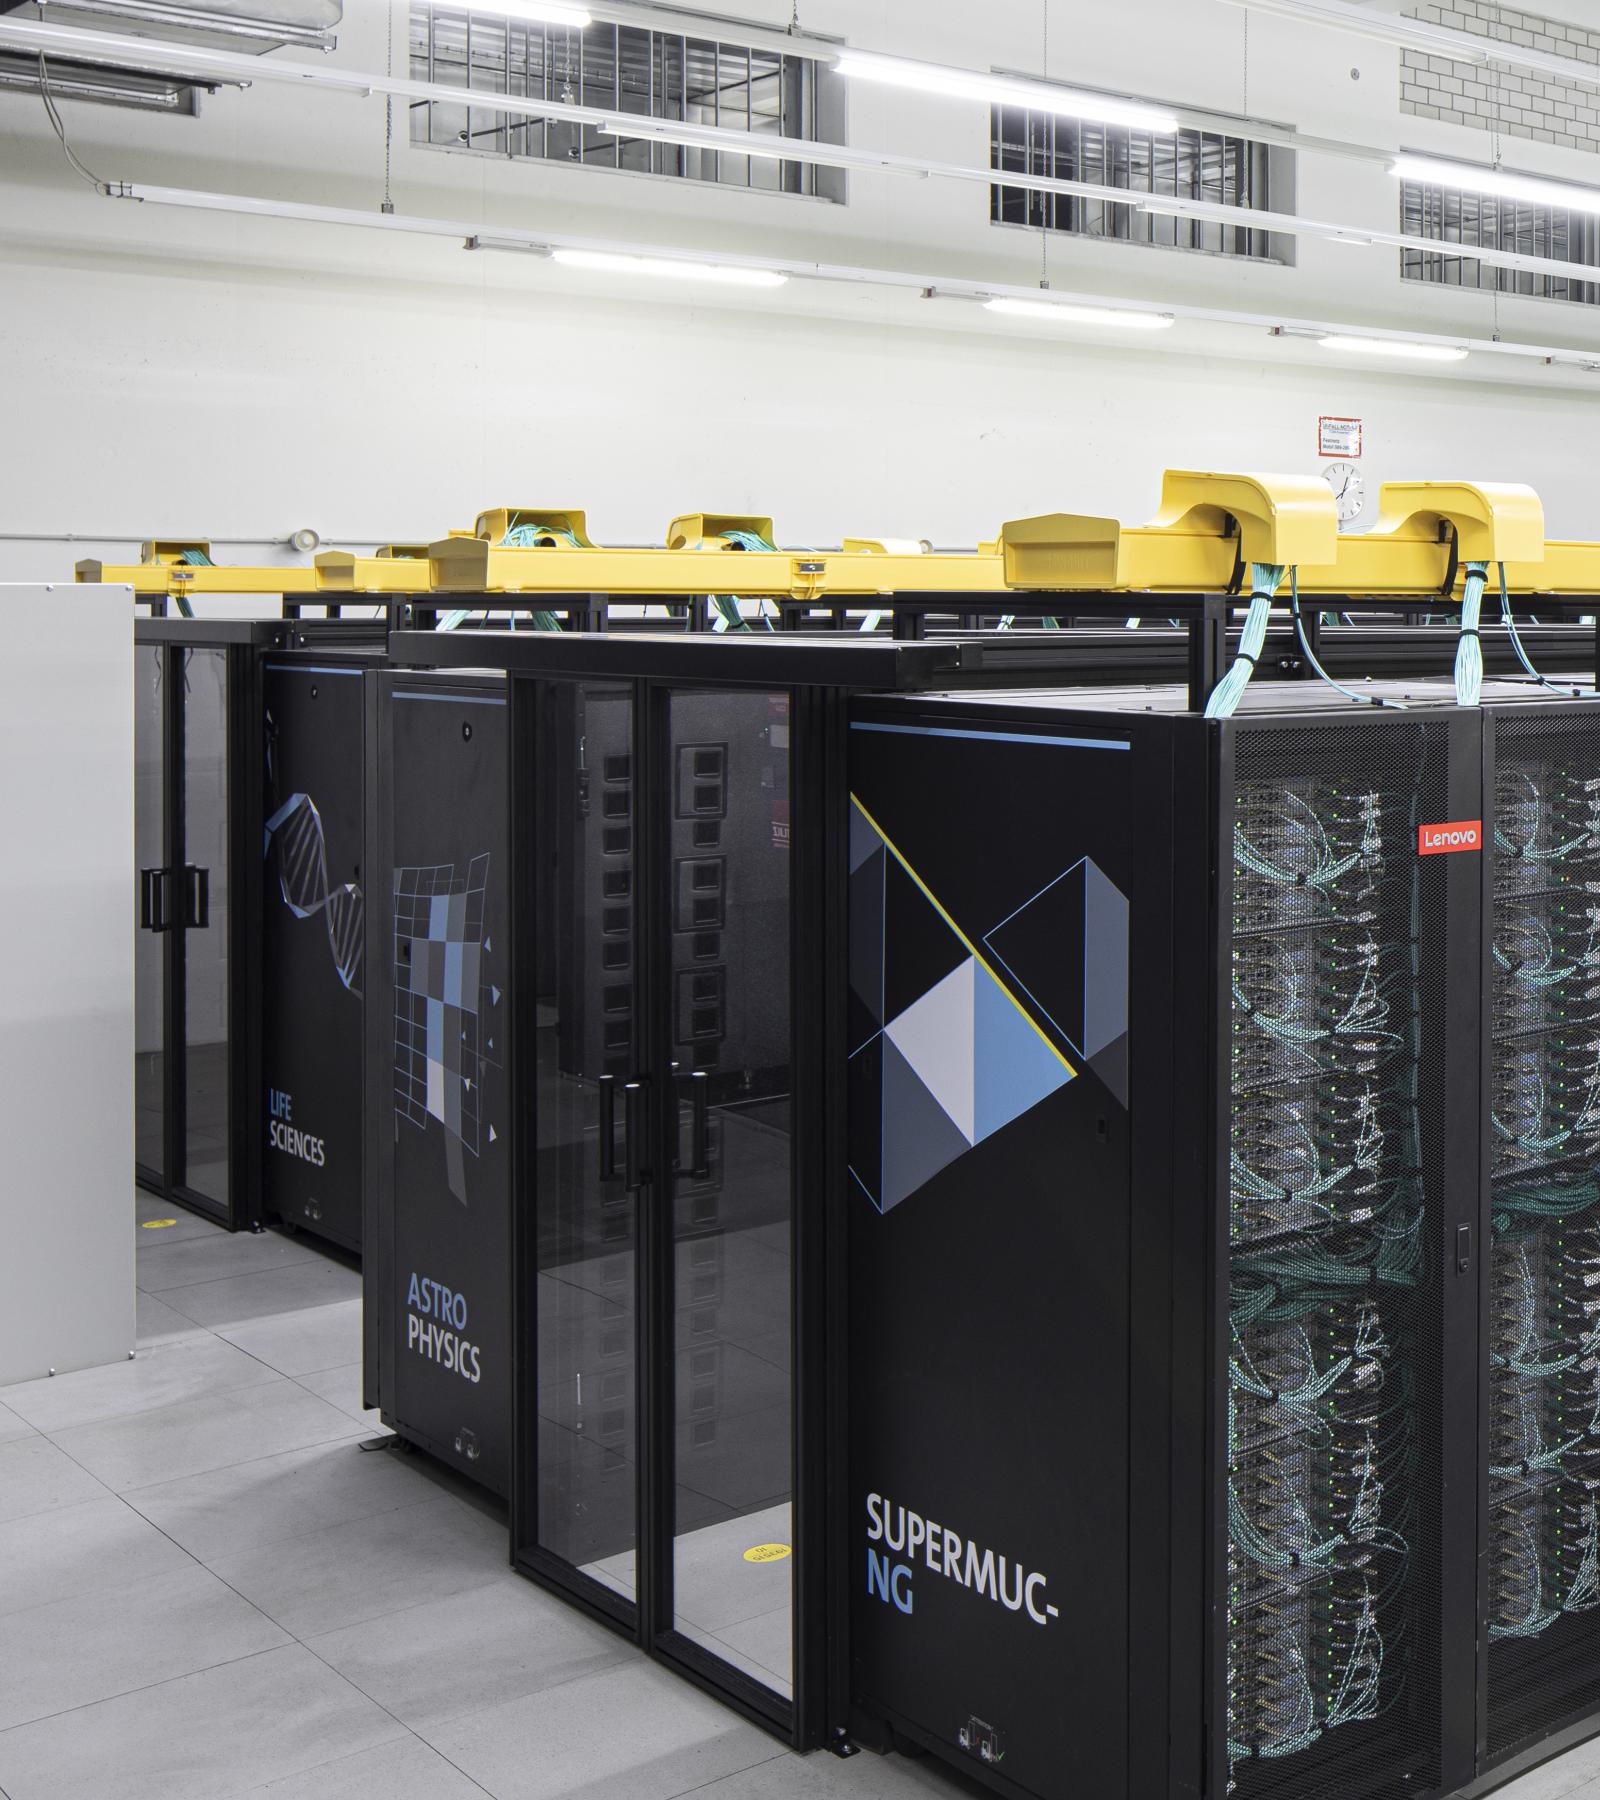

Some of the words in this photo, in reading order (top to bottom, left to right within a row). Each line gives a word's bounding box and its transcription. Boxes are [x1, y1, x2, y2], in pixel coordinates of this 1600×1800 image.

[1425, 830, 1477, 847] Lenovo
[270, 1088, 292, 1121] LIFE
[270, 1121, 325, 1167] SCIENCES
[407, 1272, 468, 1331] ASTRO
[408, 1313, 482, 1384] PHYSICS
[866, 1492, 1059, 1625] SUPERMUC-
[867, 1547, 913, 1615] NG
